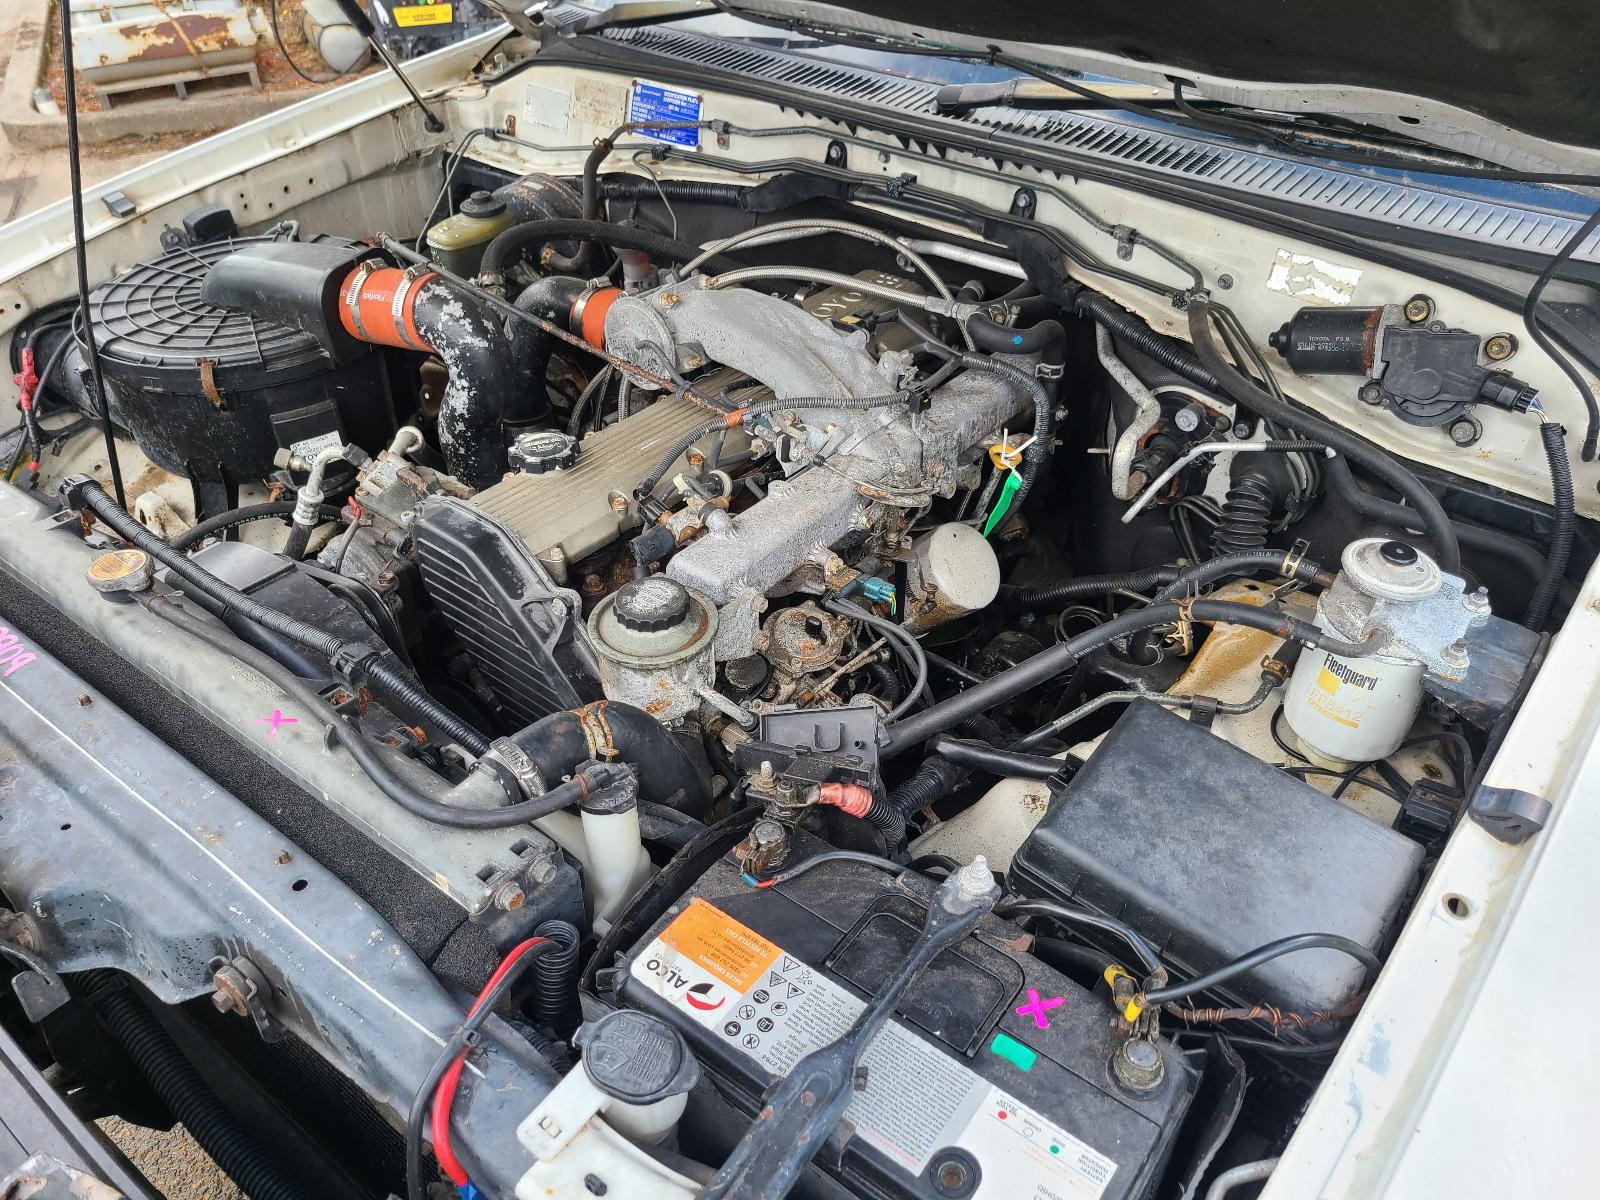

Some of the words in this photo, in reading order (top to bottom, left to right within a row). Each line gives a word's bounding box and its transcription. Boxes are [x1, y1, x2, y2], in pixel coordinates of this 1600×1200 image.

[1323, 653, 1379, 691] Fleetguard
[738, 936, 760, 951] RECYCLE
[642, 958, 689, 989] ALCO
[725, 972, 742, 984] SALES
[761, 1055, 777, 1066] 2794
[776, 1065, 787, 1073] UN
